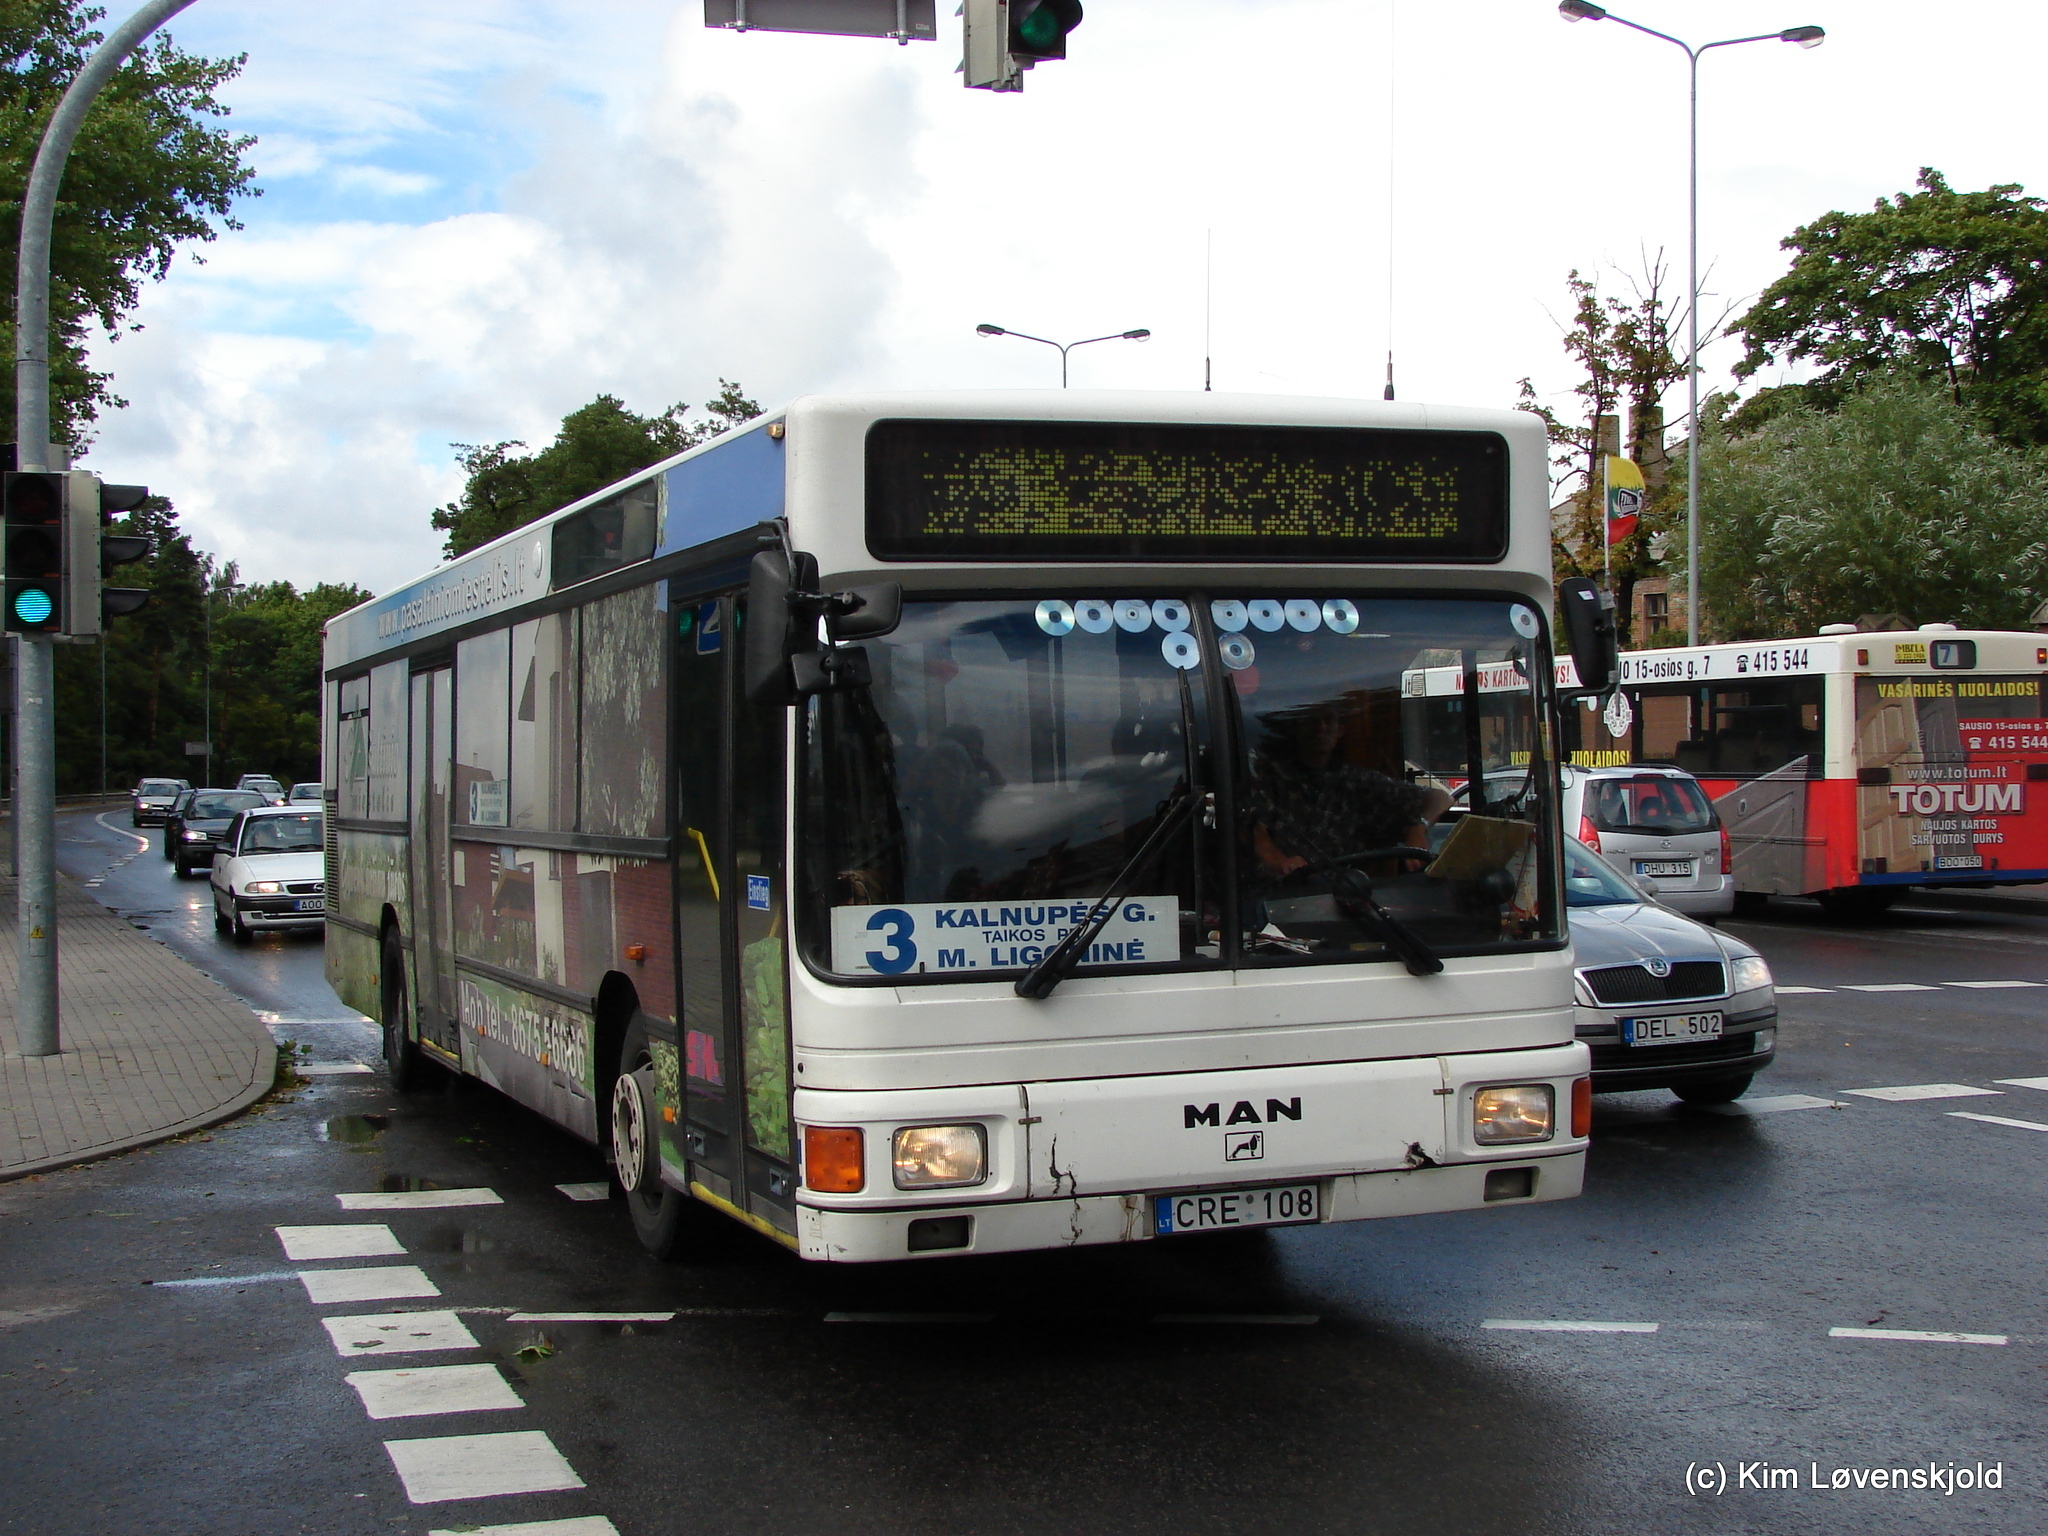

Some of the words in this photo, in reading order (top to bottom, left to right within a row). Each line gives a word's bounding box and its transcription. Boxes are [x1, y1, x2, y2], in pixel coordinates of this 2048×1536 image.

[1635, 657, 1683, 678] 15-osios
[1687, 662, 1698, 679] g.
[1703, 655, 1711, 675] 7
[1753, 651, 1778, 671] 415
[1783, 648, 1809, 669] 544
[1940, 645, 1951, 663] 7
[1878, 680, 1953, 698] VASARINĖS
[1958, 682, 2039, 697] NUOLAIDOS!
[1959, 722, 1992, 730] SAUSIO
[1995, 722, 2032, 730] 15-osios
[2034, 723, 2043, 731] g.
[1988, 736, 2016, 749] 415
[2021, 736, 2048, 748] 544
[1907, 766, 2007, 779] www.totum.lt
[471, 782, 478, 822] 3
[1889, 783, 2021, 815] TOTUM
[1921, 820, 1957, 831] NAUJOS
[1961, 819, 1997, 830] KARTOS
[1973, 833, 2003, 844] DURYS
[1643, 863, 1665, 874] DHU
[1671, 863, 1689, 873] 315
[866, 908, 918, 975] 3
[935, 902, 1110, 929] KALNUPĖS
[1123, 903, 1155, 922] G.
[982, 929, 1046, 944] TAIKOS
[938, 949, 976, 968] M.
[991, 938, 1146, 966] LIGINĖ
[511, 1003, 541, 1063] 8675
[1636, 1019, 1676, 1039] DEL
[1688, 1015, 1720, 1034] 502
[1184, 1097, 1302, 1128] MAN
[1158, 1219, 1171, 1228] LT
[1176, 1195, 1240, 1228] CRE
[1263, 1188, 1313, 1219] 108
